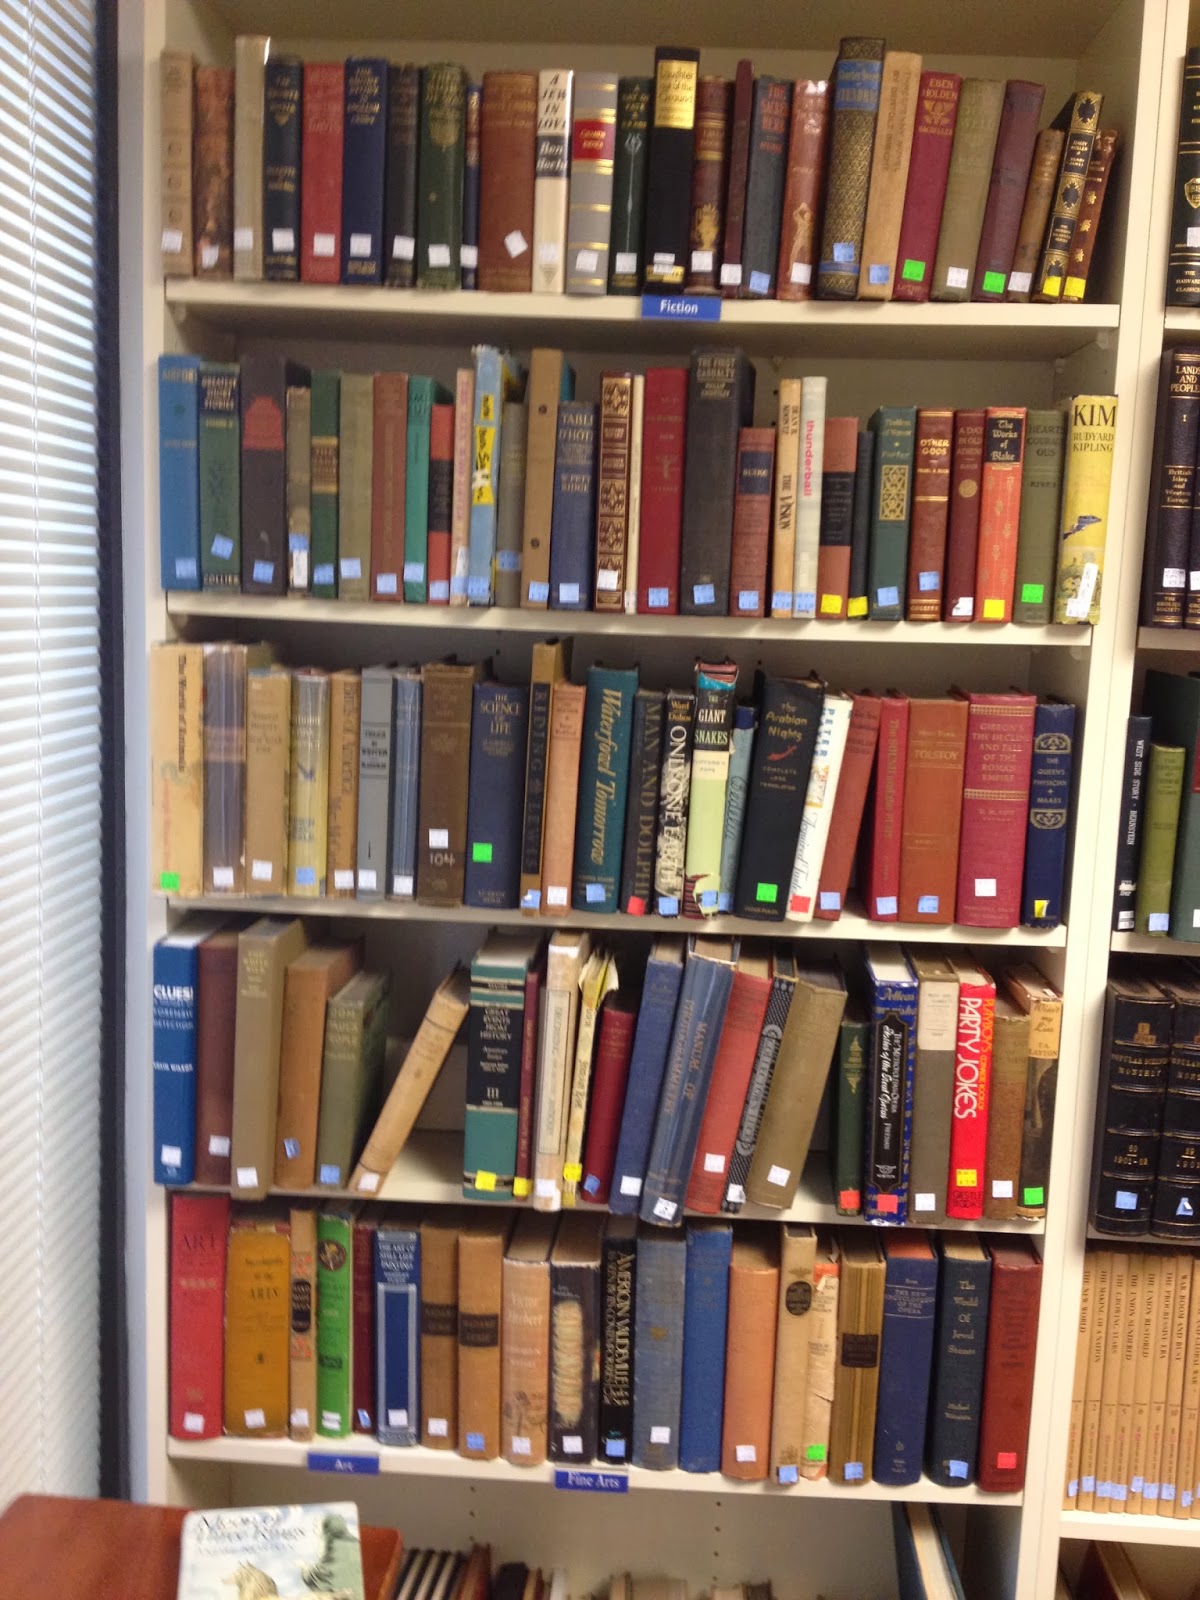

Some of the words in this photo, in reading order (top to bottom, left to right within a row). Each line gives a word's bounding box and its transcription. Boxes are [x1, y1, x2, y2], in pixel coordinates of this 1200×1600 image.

[550, 74, 561, 85] A
[929, 78, 954, 88] EBEN
[923, 89, 958, 100] HOLDEN
[541, 141, 563, 154] Ben
[660, 299, 699, 315] Fiction
[1175, 365, 1200, 375] LANDS
[1179, 375, 1197, 383] AND
[1073, 404, 1117, 427] KIM
[997, 420, 1014, 429] The
[967, 427, 984, 435] DAY
[992, 429, 1018, 439] Works
[1073, 431, 1115, 442] RUDYARD
[920, 438, 950, 447] OTHER
[968, 437, 983, 445] OLD
[1000, 440, 1008, 449] of
[922, 447, 948, 456] GODS
[1072, 442, 1113, 453] KIPLING
[804, 420, 815, 497] thunderball
[991, 451, 1015, 461] Blake
[782, 474, 792, 491] THE
[480, 701, 520, 715] SCIENCE
[670, 701, 690, 710] Ward
[781, 703, 797, 713] the
[698, 709, 726, 723] GIANT
[765, 710, 808, 726] Arabian
[645, 702, 661, 750] MAN
[979, 723, 1024, 732] GIBBON'S
[594, 688, 622, 777] Waterfowl
[695, 730, 728, 745] SNAKES
[767, 725, 803, 741] Nights
[820, 708, 836, 758] PETER
[972, 732, 989, 741] THE
[979, 743, 999, 751] AND
[1002, 744, 1023, 752] FALL
[1135, 739, 1145, 758] WEST
[913, 749, 959, 761] TOLSTOY
[983, 753, 997, 761] OF
[999, 754, 1017, 762] THE
[1046, 757, 1060, 765] THE
[981, 764, 1017, 772] ROMAN
[1133, 760, 1142, 777] SIDE
[981, 774, 1016, 782] EMPIRE
[1033, 779, 1067, 787] PHYSICIAN
[641, 765, 659, 808] AND
[1131, 779, 1141, 801] STORY
[590, 781, 616, 865] Tomorrow
[1126, 810, 1139, 846] BERNSTEIN
[430, 851, 456, 867] 104
[634, 814, 655, 897] DOLPHI
[153, 984, 194, 1001] CLUES!
[958, 997, 983, 1053] PARTY
[981, 997, 995, 1053] PLAYBOY'S
[480, 1030, 512, 1040] HISTORY
[1029, 1049, 1058, 1057] LAYTON
[1118, 1066, 1162, 1078] MONTHLY
[954, 1053, 980, 1119] JOKES
[952, 1190, 983, 1199] CASTLE
[952, 1199, 983, 1208] BOOKS
[184, 1233, 216, 1252] ART
[1083, 1271, 1091, 1284] THE
[1180, 1274, 1188, 1290] WAR
[958, 1279, 976, 1291] The
[910, 1302, 923, 1310] THE
[953, 1296, 979, 1308] World
[1127, 1292, 1136, 1317] UNION
[1177, 1294, 1186, 1321] BOOM
[897, 1307, 921, 1315] OPERA
[958, 1313, 972, 1323] Of
[1079, 1306, 1088, 1333] WORLD
[952, 1329, 975, 1341] Jewel
[567, 1472, 593, 1487] Fine
[596, 1473, 620, 1489] Arts
